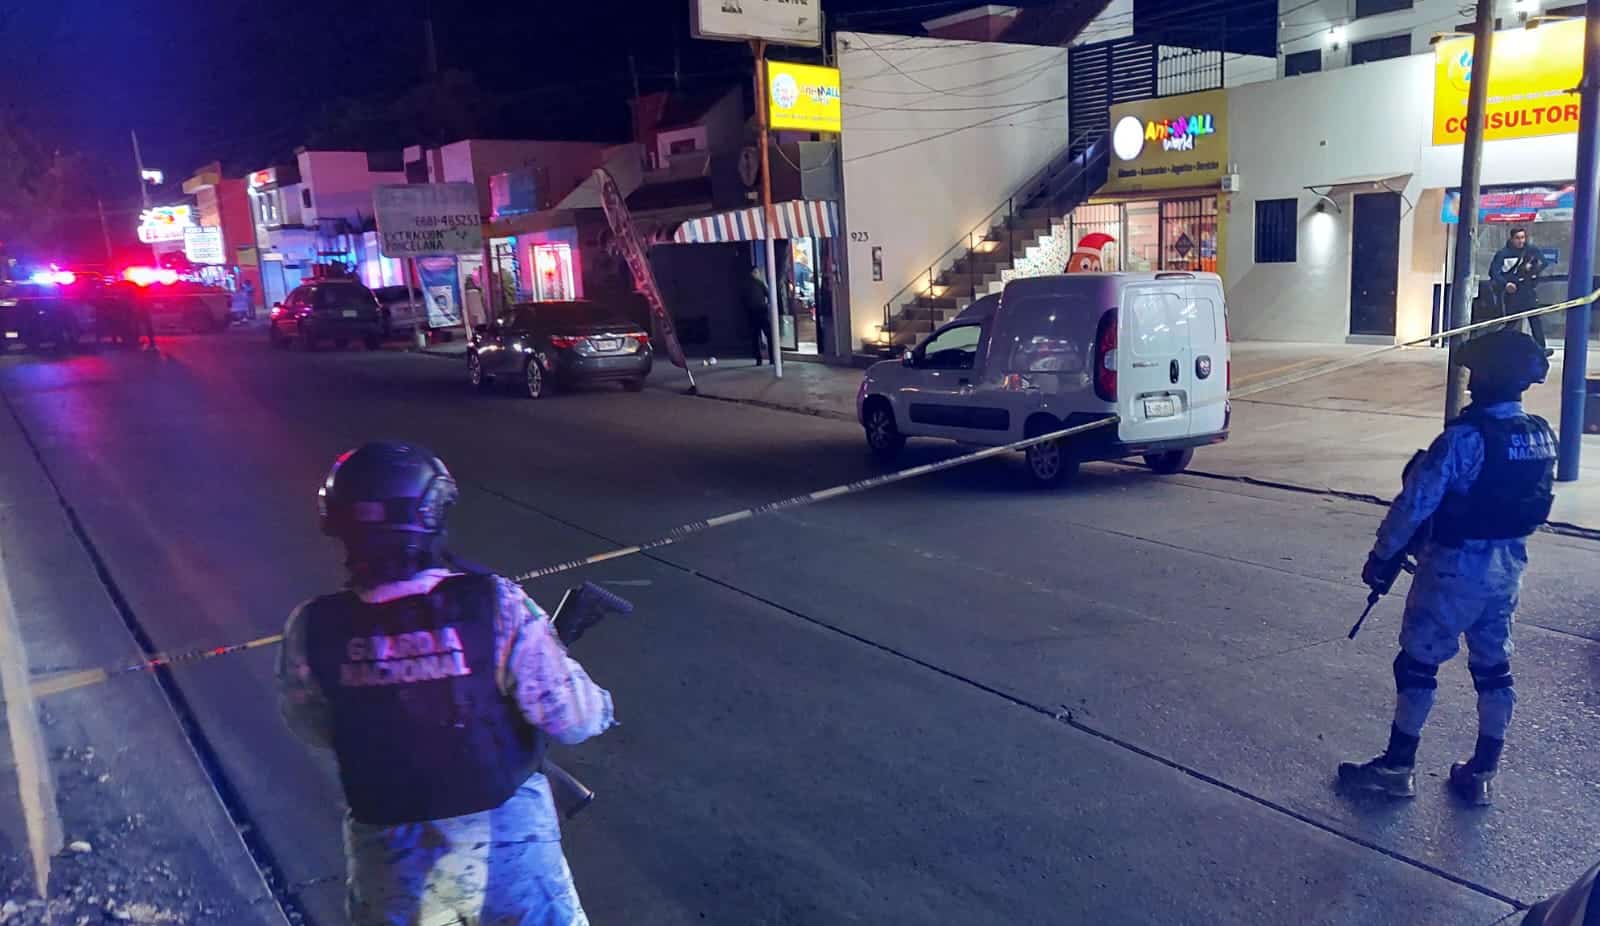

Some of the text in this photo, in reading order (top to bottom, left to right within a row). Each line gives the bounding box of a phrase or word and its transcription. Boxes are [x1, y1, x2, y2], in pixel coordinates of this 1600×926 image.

[1144, 113, 1214, 141] Ani-MALL
[850, 231, 869, 242] 923
[347, 626, 463, 660] GUARDIA
[339, 650, 472, 686] NACIONAL
